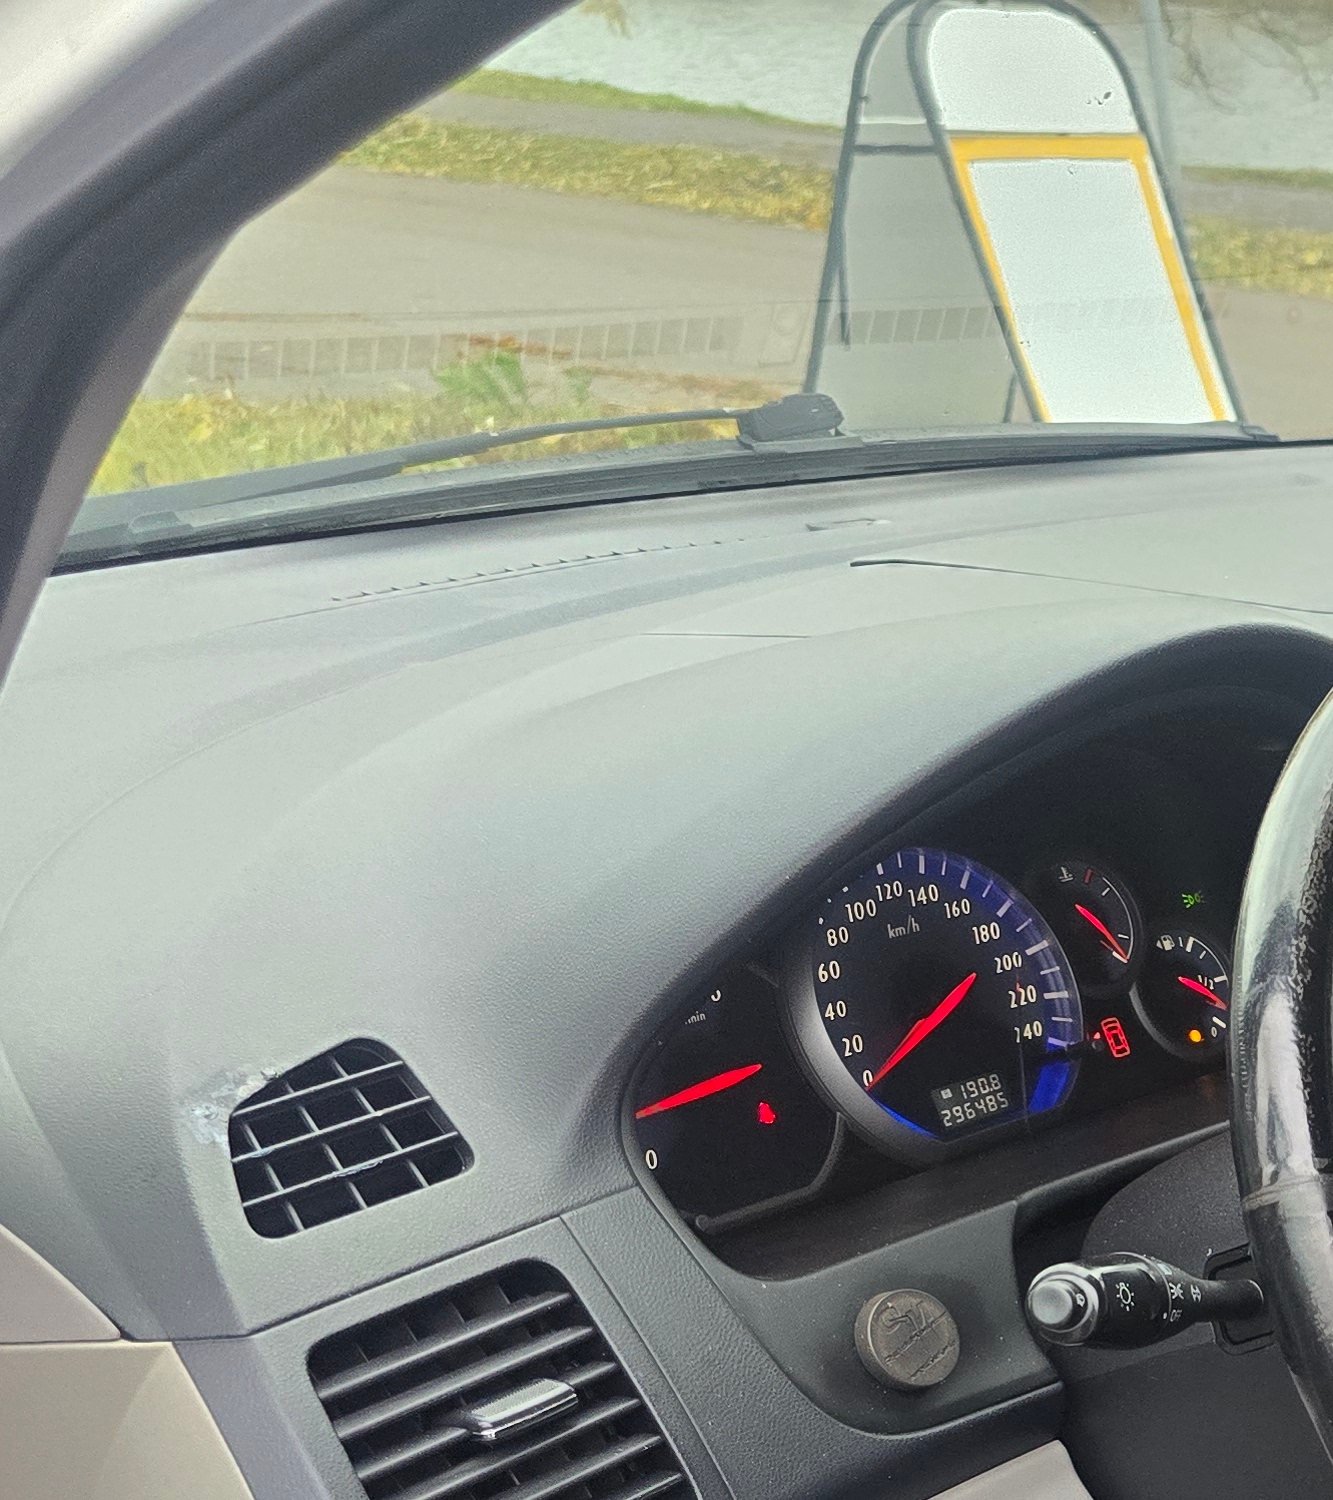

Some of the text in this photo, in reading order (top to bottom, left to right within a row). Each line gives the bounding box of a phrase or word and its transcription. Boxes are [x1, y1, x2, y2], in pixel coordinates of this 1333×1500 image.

[876, 881, 903, 901] 120
[908, 884, 939, 907] 140
[845, 899, 877, 922] 100
[944, 898, 971, 919] 160
[826, 926, 849, 947] 80
[887, 914, 920, 938] km/h
[972, 921, 1001, 944] 180
[818, 960, 841, 983] 60
[994, 951, 1022, 974] 200
[1008, 984, 1037, 1009] 220
[824, 1000, 847, 1021] 40
[842, 1034, 863, 1057] 20
[862, 1069, 874, 1087] 0
[940, 1091, 1009, 1127] 296485
[645, 1149, 658, 1170] 0
